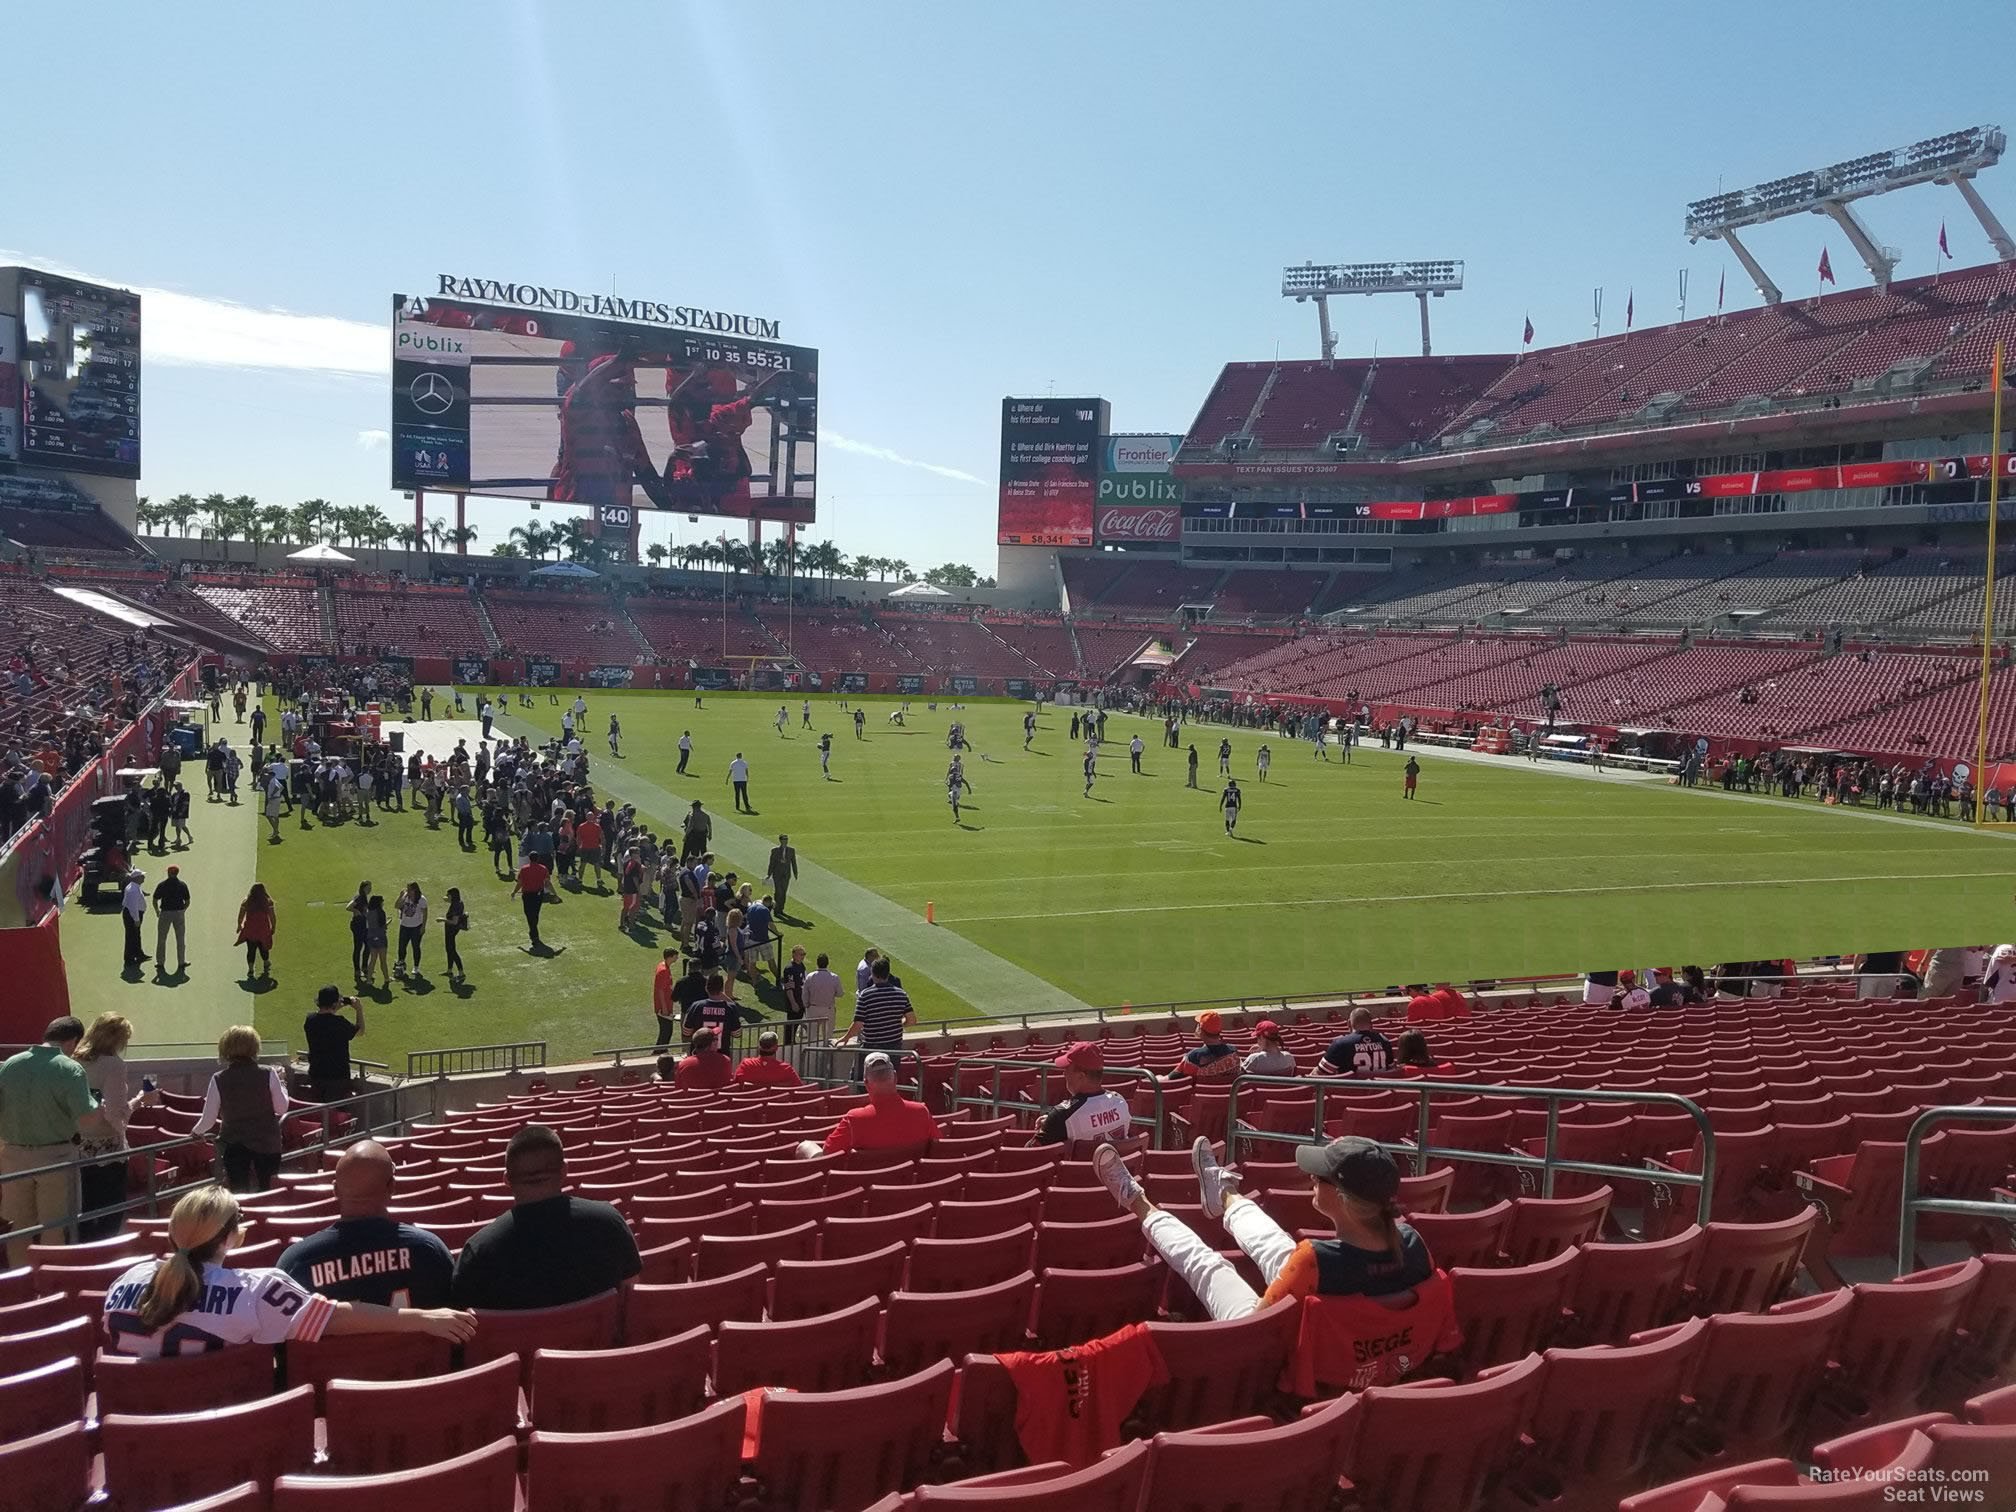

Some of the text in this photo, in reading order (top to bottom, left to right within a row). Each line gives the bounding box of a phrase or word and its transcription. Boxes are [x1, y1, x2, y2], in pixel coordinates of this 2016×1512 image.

[438, 273, 781, 339] RAYMOND JAMES STADIUM
[526, 320, 538, 335] 0
[399, 332, 463, 353] Publix
[685, 346, 700, 357] 1ST
[706, 349, 720, 360] 10
[725, 351, 740, 363] 35
[123, 360, 132, 368] 17
[746, 351, 791, 370] 55:21
[1017, 442, 1034, 451] Where
[1035, 442, 1044, 451] did
[1010, 455, 1019, 463] his
[1020, 455, 1032, 463] first
[1032, 455, 1052, 465] college
[1052, 455, 1076, 465] coaching
[1118, 448, 1168, 460] Frontier
[1099, 479, 1177, 499] Publix
[1686, 482, 1701, 494] VS
[606, 509, 628, 523] 40
[1355, 506, 1370, 515] VS
[1099, 509, 1178, 537] Coca-Cola
[1031, 535, 1063, 544] $8,341
[703, 1006, 727, 1016] BUTKUS
[1355, 1042, 1384, 1052] PAYTON
[1090, 1107, 1121, 1128] EVANS
[311, 1247, 412, 1288] URLACHER
[1352, 1325, 1415, 1364] SIEGE
